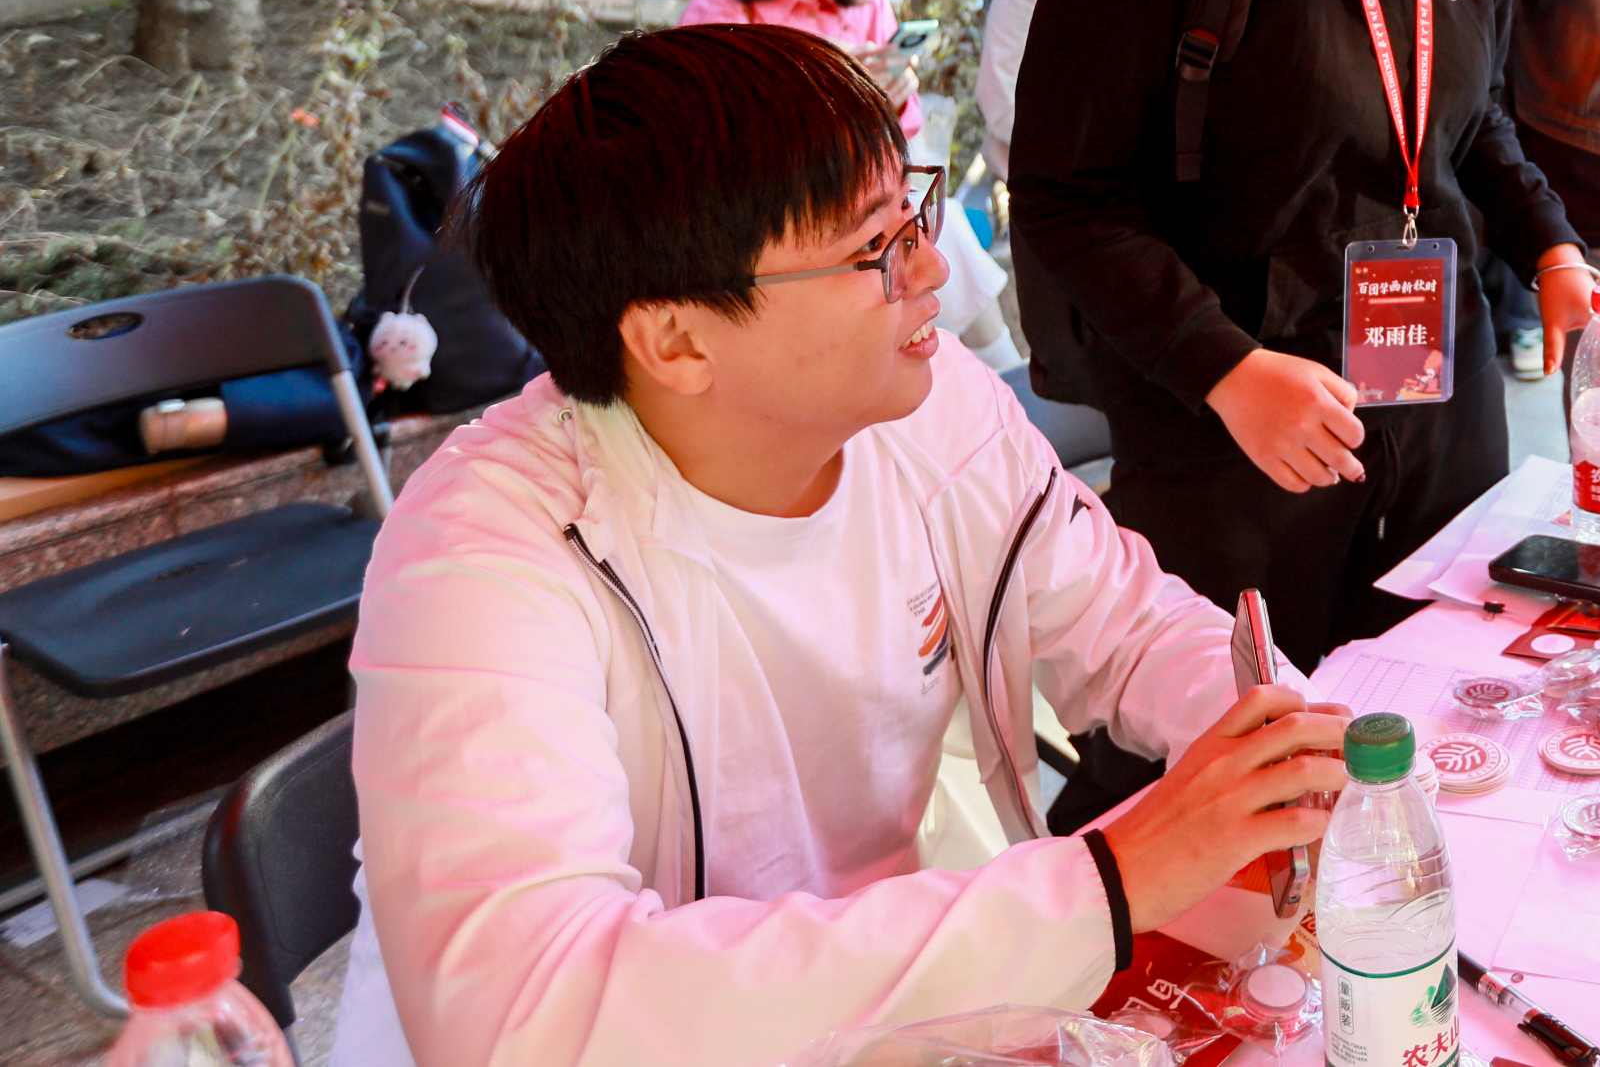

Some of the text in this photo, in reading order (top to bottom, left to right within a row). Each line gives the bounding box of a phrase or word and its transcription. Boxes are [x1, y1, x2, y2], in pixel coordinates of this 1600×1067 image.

[1381, 52, 1396, 89] PEKING
[1421, 50, 1429, 87] PEKING
[1364, 324, 1428, 347] 邓雨佳
[1340, 981, 1352, 1028] 量贩装
